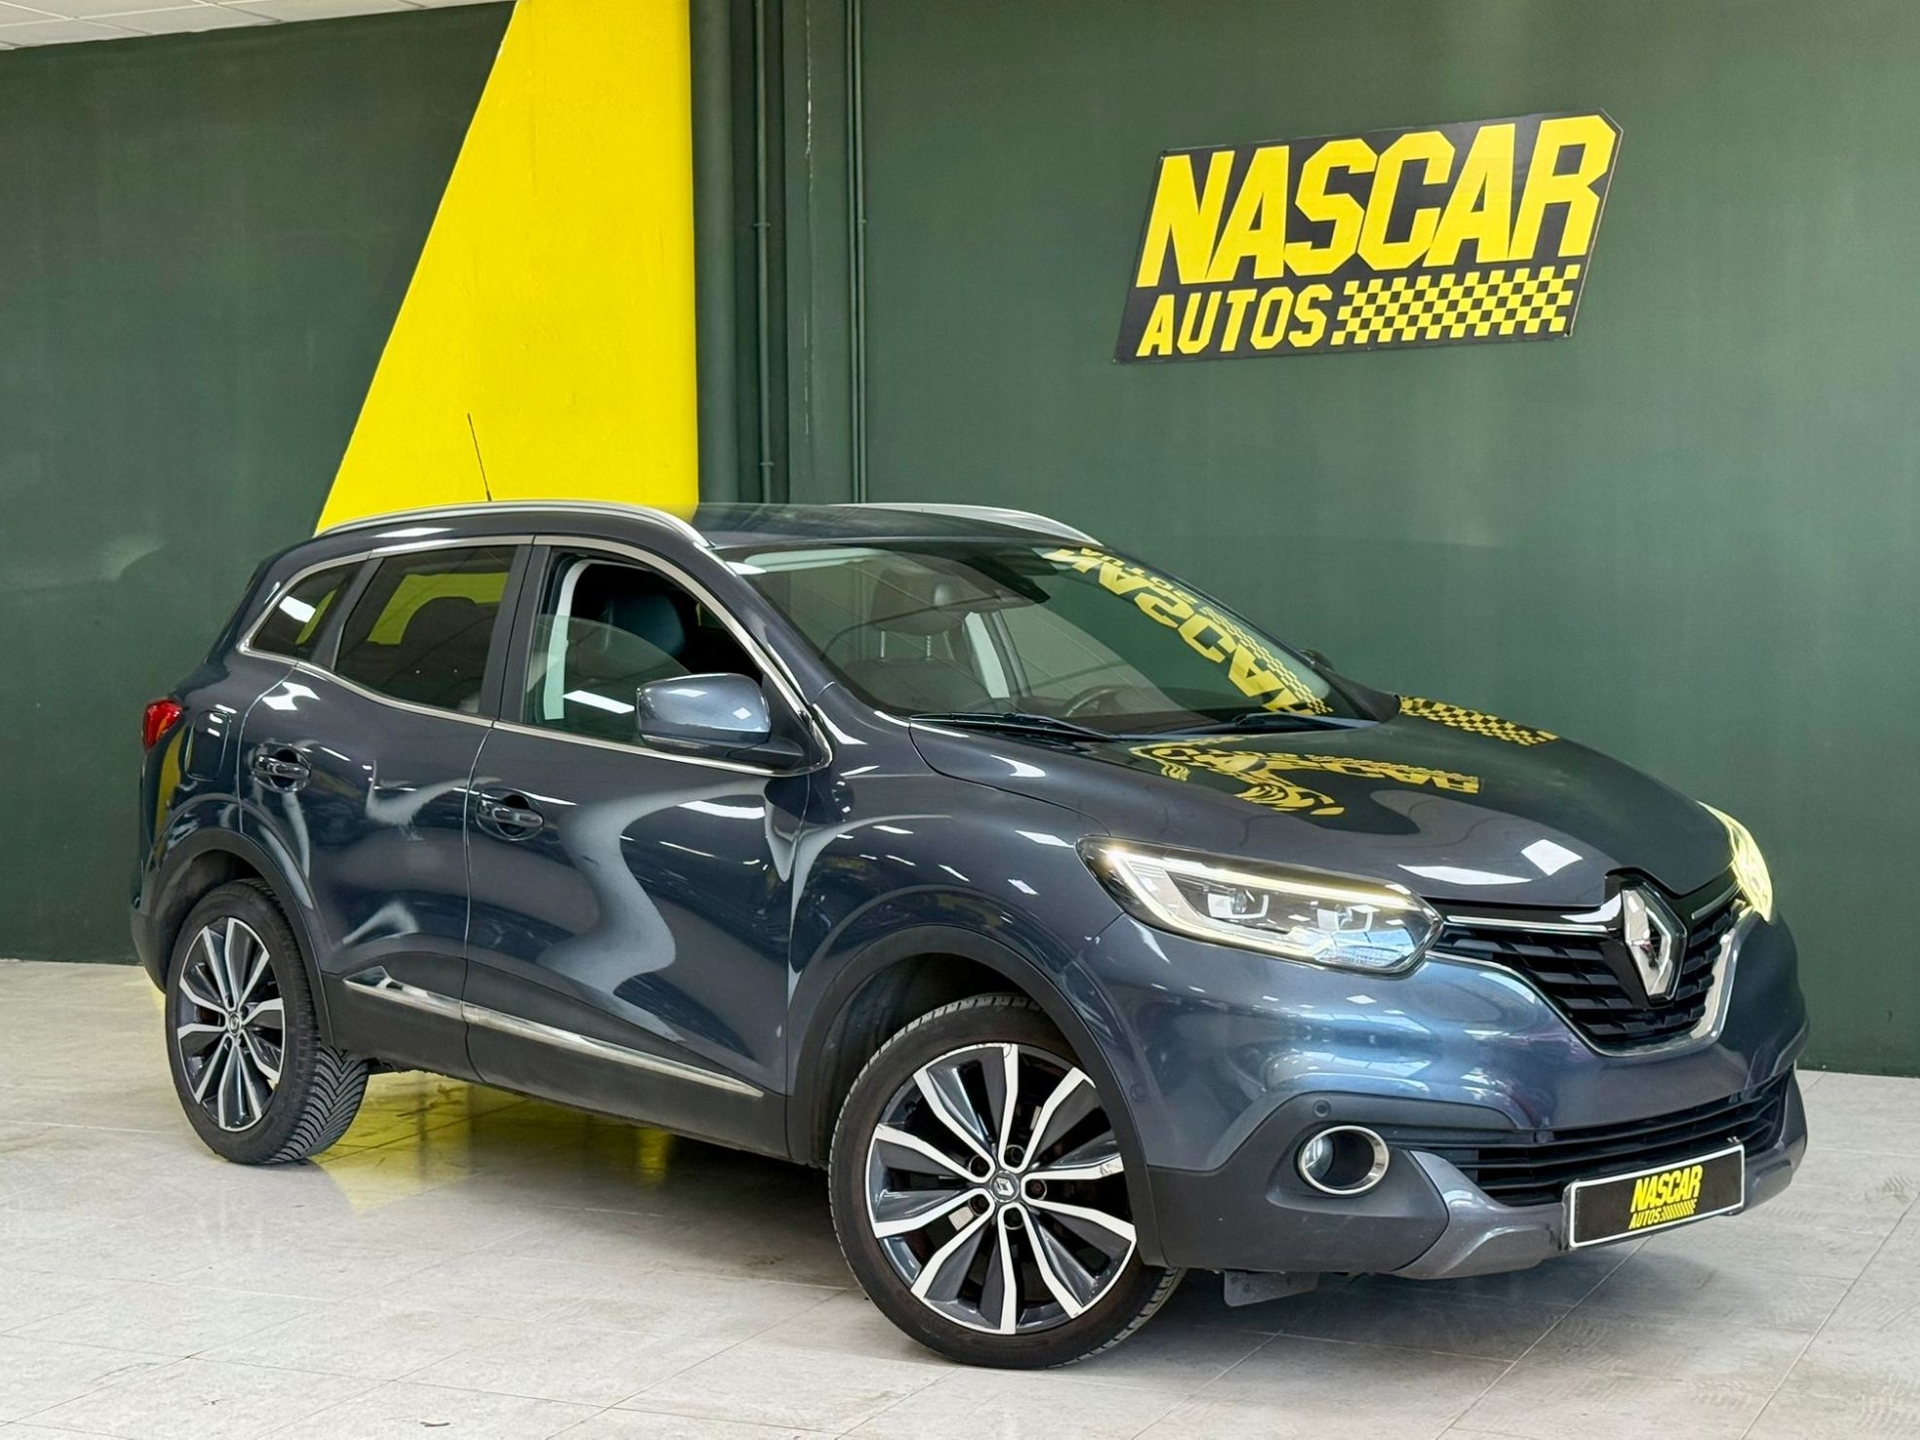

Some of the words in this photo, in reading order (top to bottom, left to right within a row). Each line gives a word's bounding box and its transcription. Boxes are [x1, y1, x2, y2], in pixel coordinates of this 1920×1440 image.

[1135, 114, 1617, 288] NASCAR
[1135, 284, 1333, 357] AUTOS
[1629, 1208, 1661, 1229] AUTOS
[1630, 1165, 1703, 1212] NASCAR
